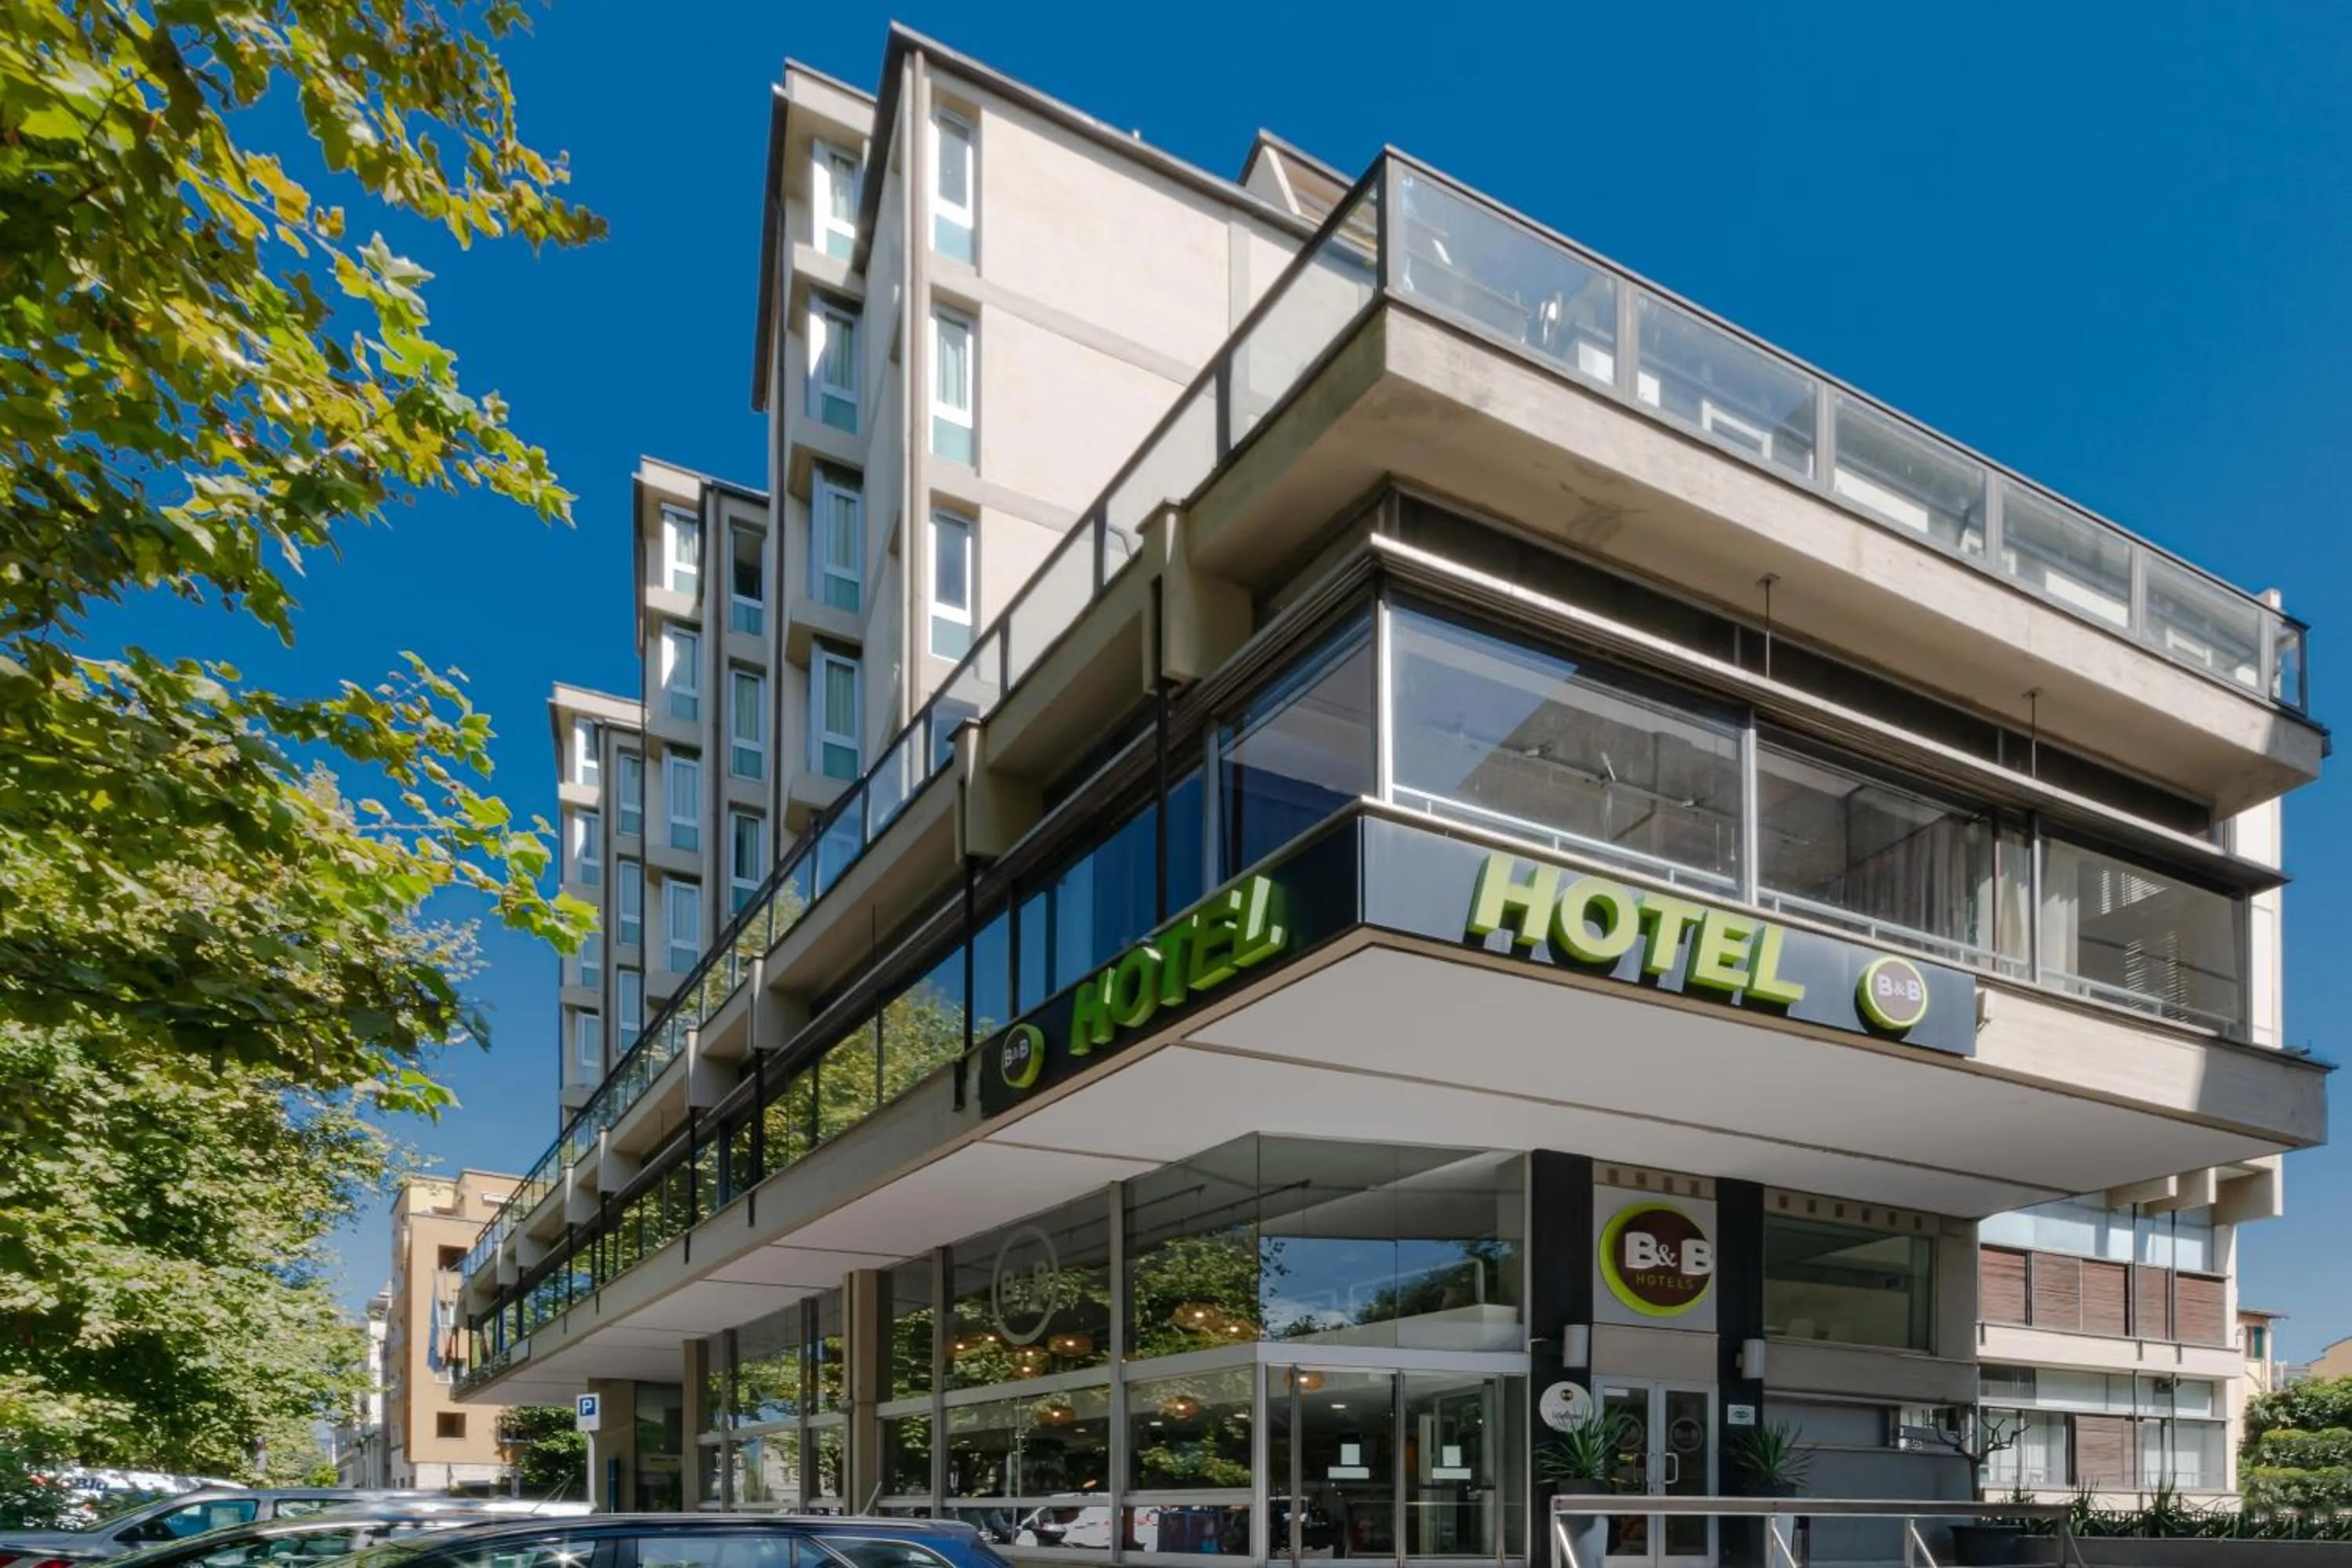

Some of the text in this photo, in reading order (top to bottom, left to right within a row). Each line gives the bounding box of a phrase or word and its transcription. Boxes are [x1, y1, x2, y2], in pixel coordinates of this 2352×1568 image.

[1468, 852, 1805, 1007] HOTEL
[1070, 876, 1287, 1055] HOTEL
[1877, 975, 1920, 1001] B&B
[1004, 1039, 1029, 1068] B&B
[1625, 1232, 1715, 1276] B&B
[1635, 1273, 1694, 1290] HOTELS
[583, 1399, 593, 1415] P
